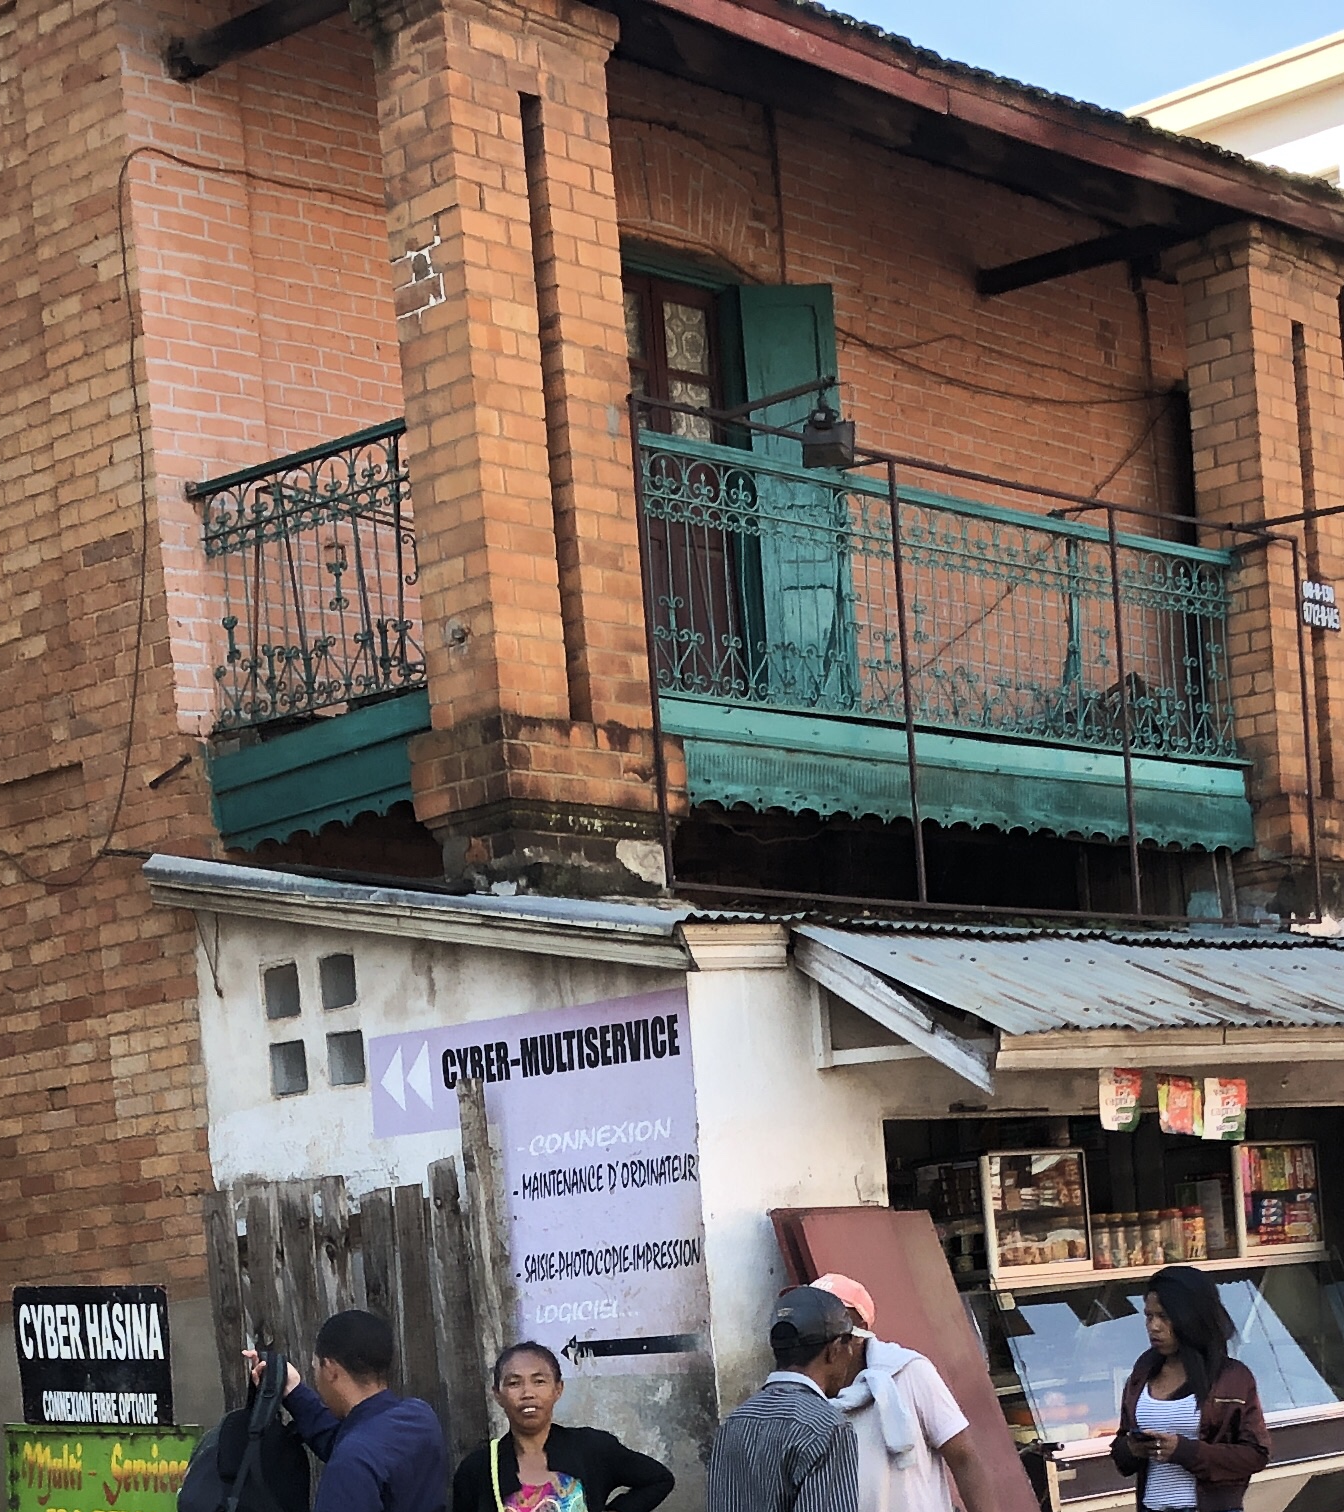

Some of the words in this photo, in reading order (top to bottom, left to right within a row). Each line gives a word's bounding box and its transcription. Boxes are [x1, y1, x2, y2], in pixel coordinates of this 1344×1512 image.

[441, 1014, 681, 1090] CYBER-MULTISERVICE
[528, 1117, 672, 1156] CONNEXION
[522, 1163, 604, 1201] MAINTENANCE
[19, 1303, 85, 1360] CYBER
[85, 1302, 165, 1360] HASINA
[42, 1390, 92, 1423] CONNEXION
[92, 1391, 119, 1423] FIBRE
[118, 1392, 159, 1425] OPTIQUE
